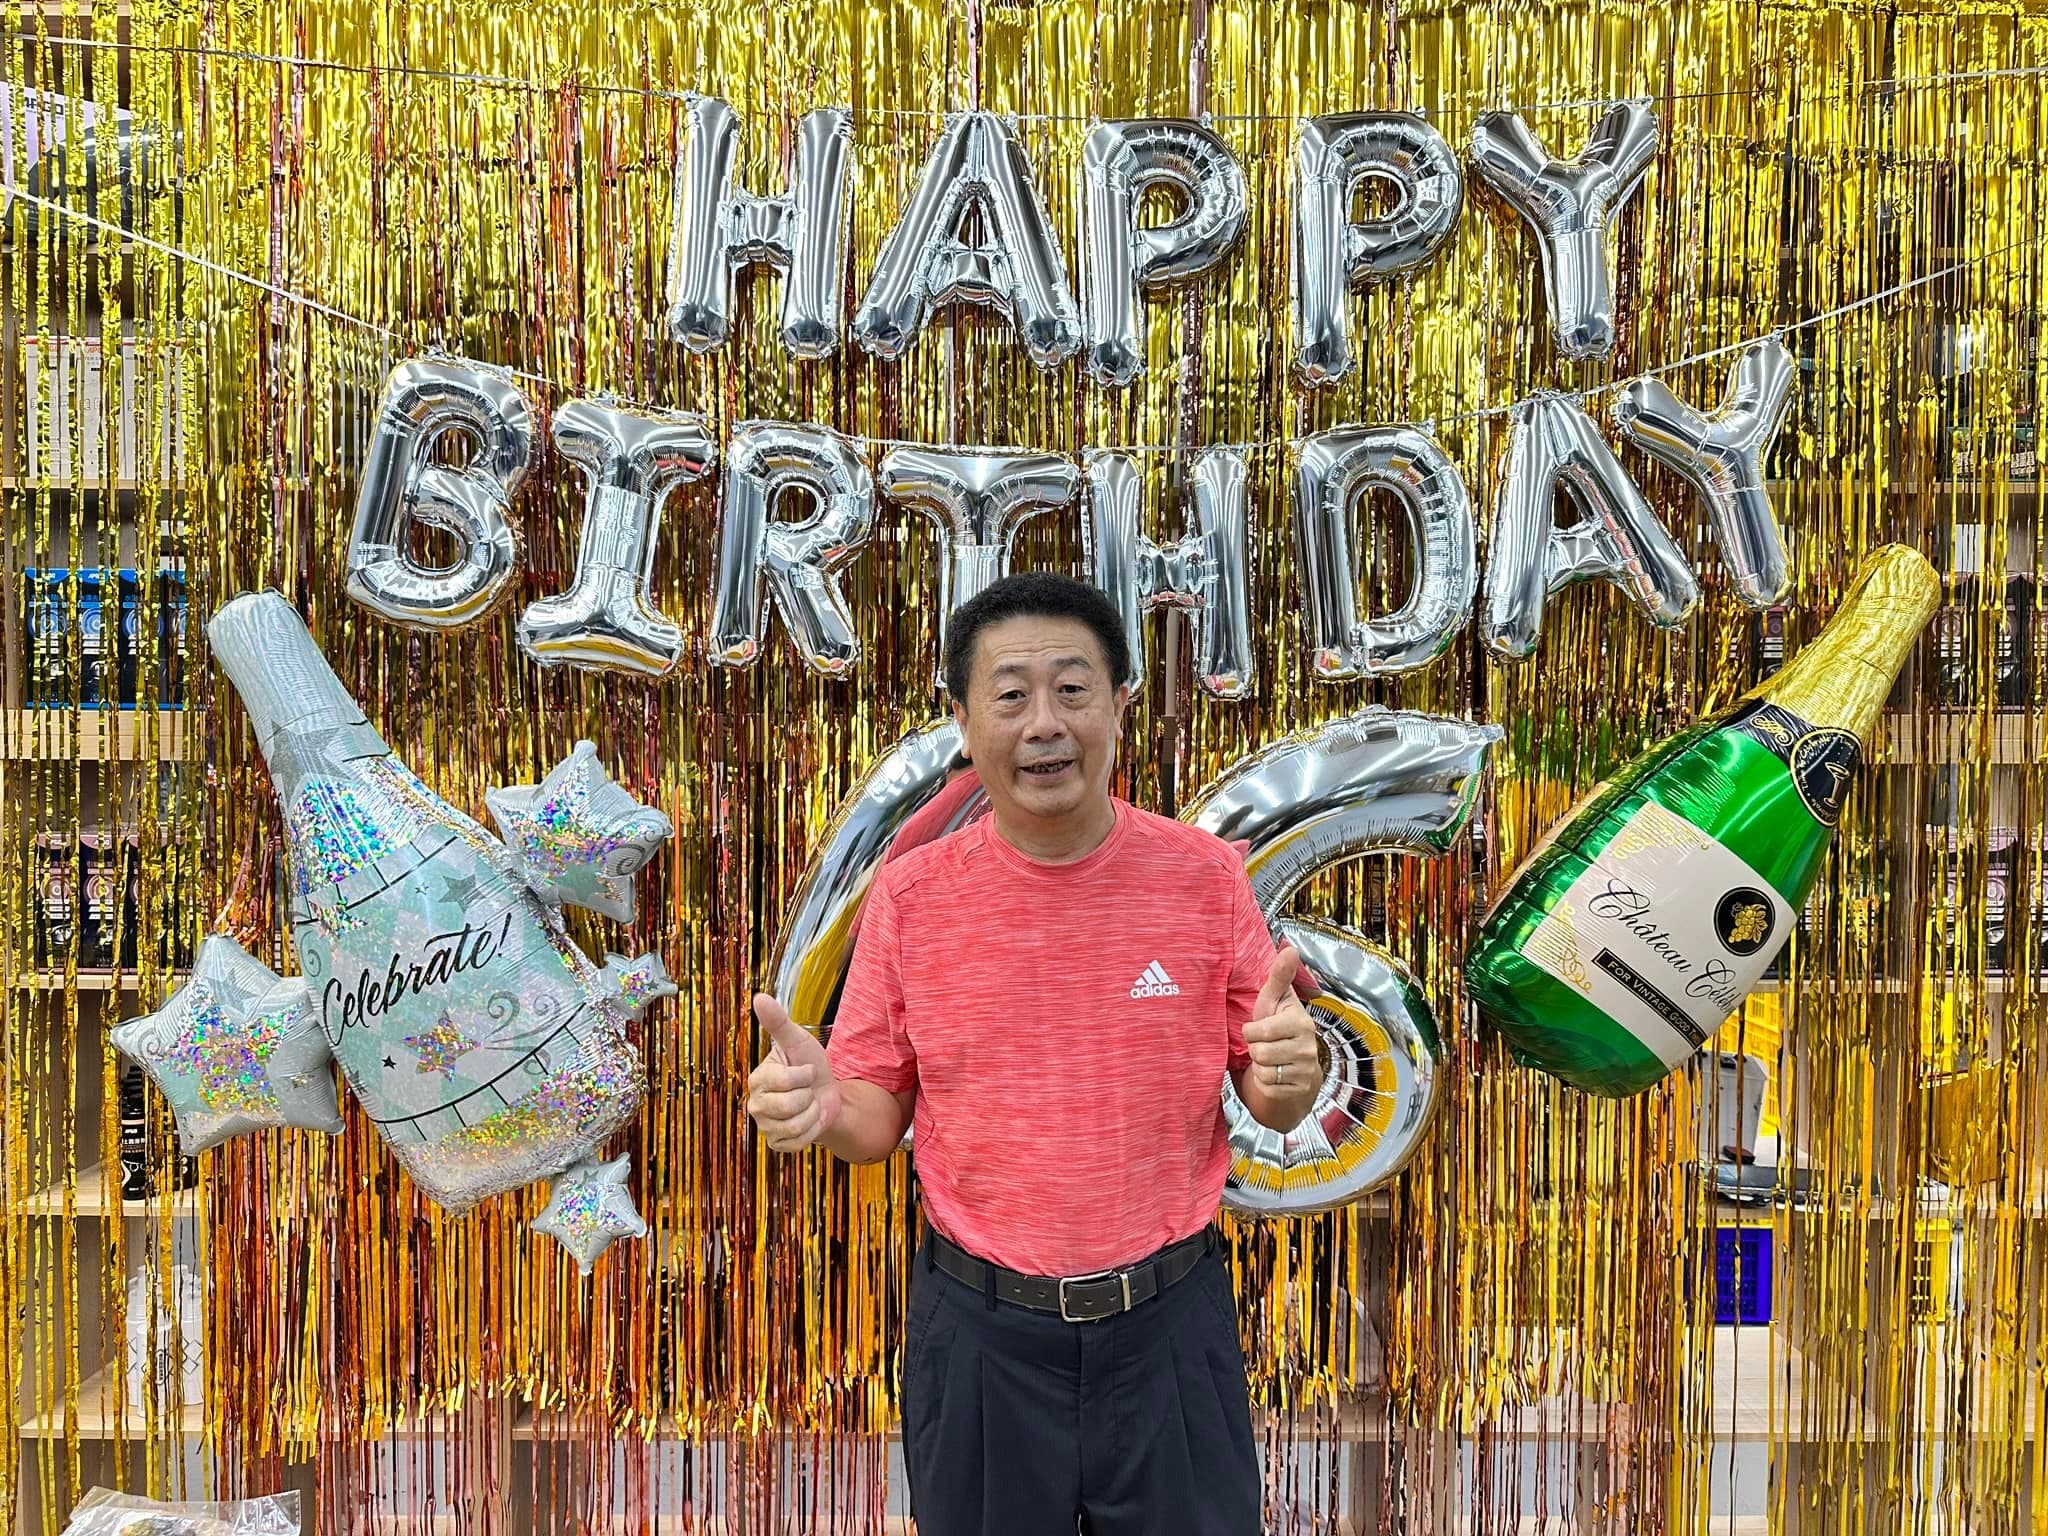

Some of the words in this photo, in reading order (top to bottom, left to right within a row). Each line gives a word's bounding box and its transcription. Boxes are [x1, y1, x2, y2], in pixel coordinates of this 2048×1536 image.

[668, 97, 1659, 388] HAPPY
[346, 336, 1797, 700] BIRTHDAY
[322, 912, 513, 1046] Celebrate!
[1588, 878, 1692, 973] Château
[1130, 984, 1180, 999] adidas
[1607, 960, 1631, 982] FOR
[1633, 978, 1671, 1016] VINTAGE
[1669, 1011, 1691, 1034] GOOD
